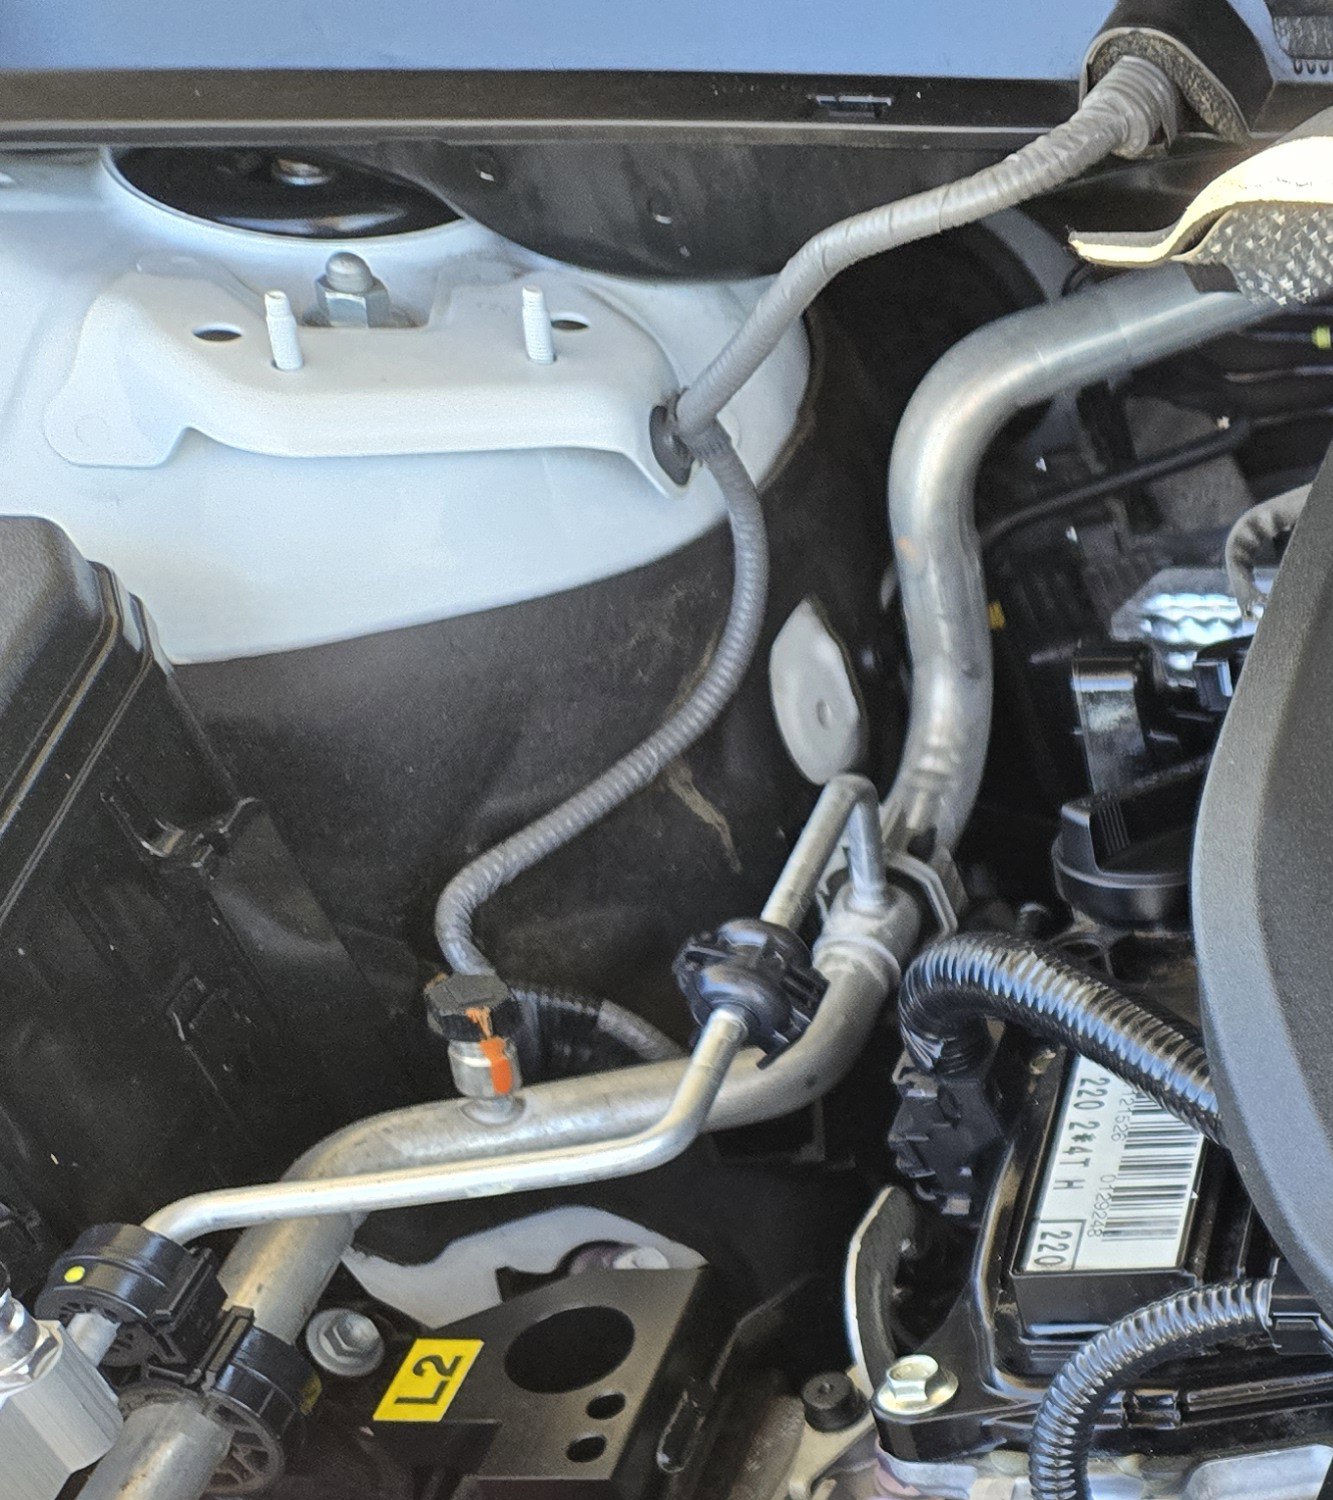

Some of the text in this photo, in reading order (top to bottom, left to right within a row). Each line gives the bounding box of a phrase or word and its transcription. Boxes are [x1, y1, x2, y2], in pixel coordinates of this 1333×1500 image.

[1073, 1077, 1111, 1110] 220
[1087, 1088, 1137, 1238] 121526 0129248
[1053, 1178, 1086, 1190] H
[1033, 1230, 1073, 1267] 220
[393, 1354, 464, 1406] L2
